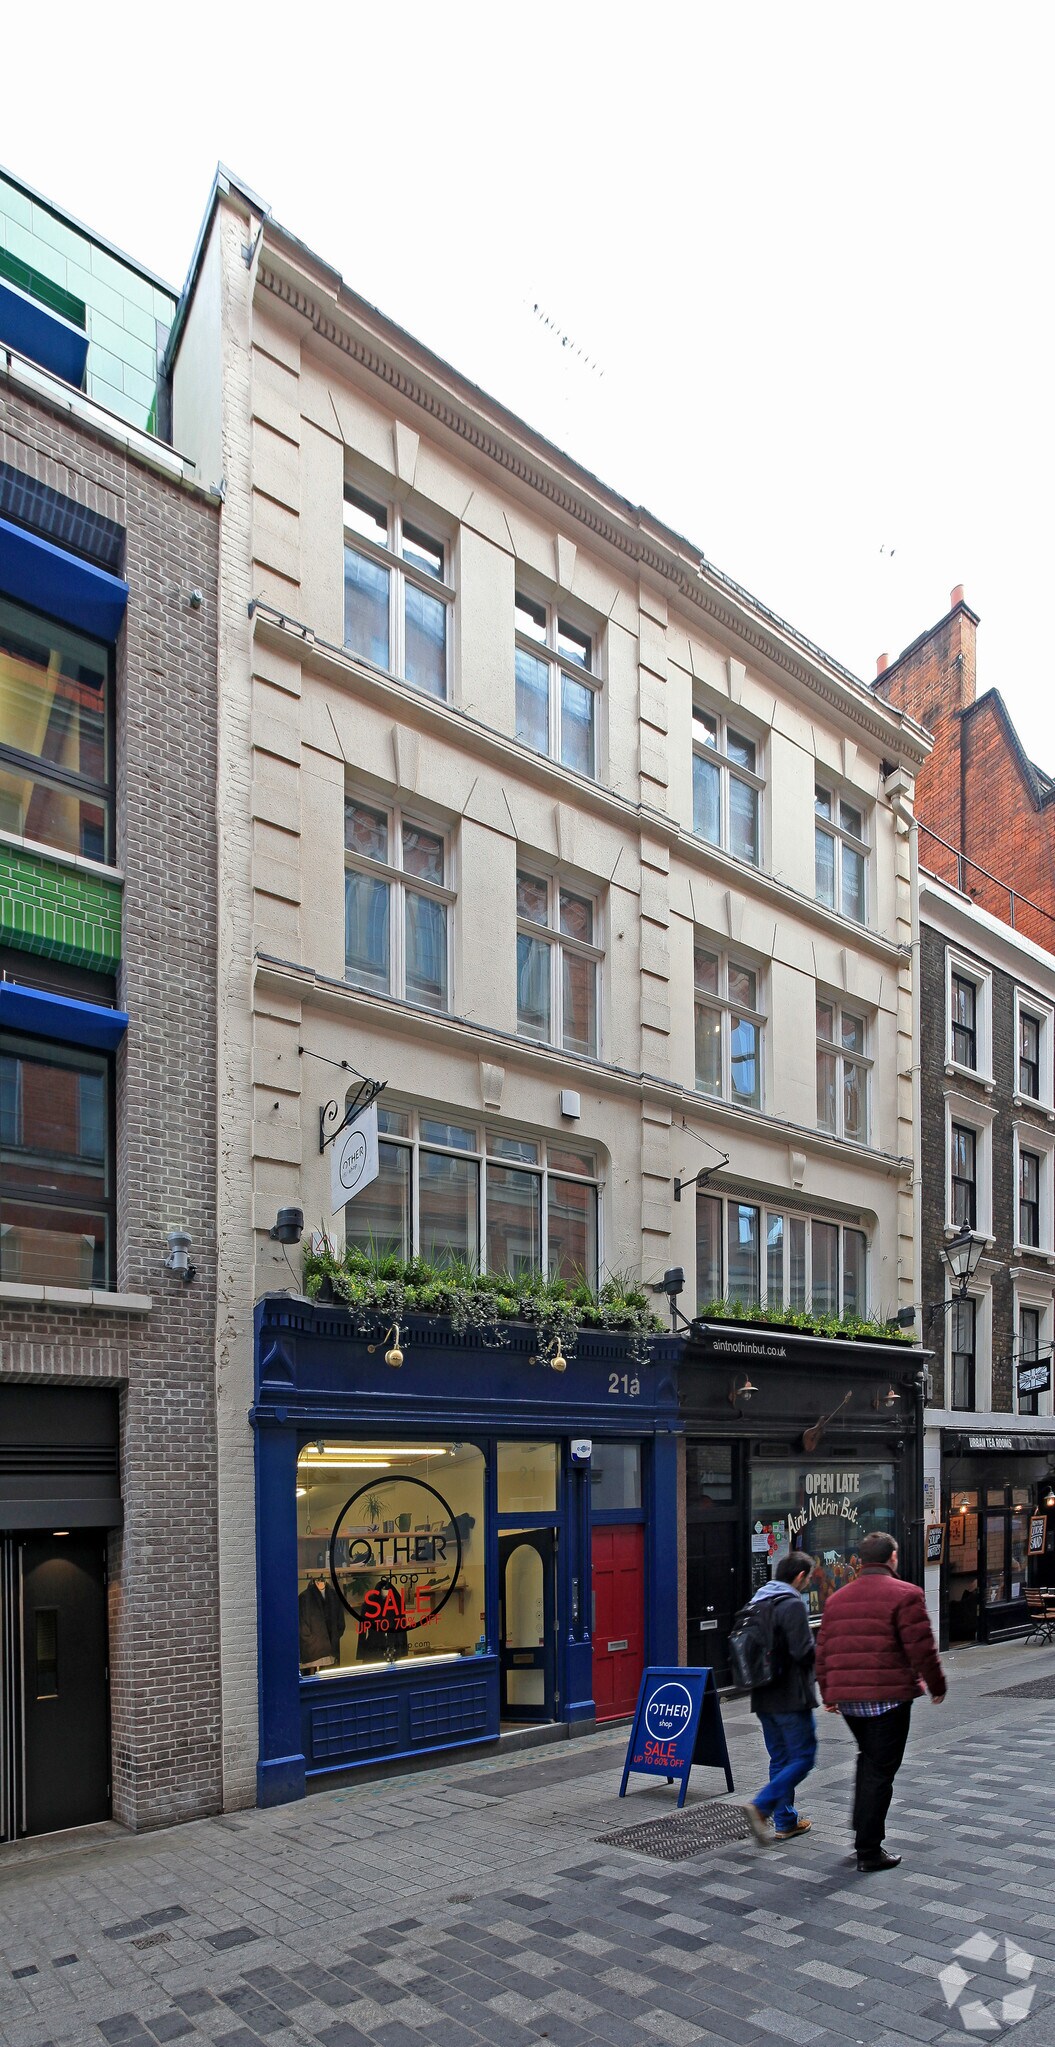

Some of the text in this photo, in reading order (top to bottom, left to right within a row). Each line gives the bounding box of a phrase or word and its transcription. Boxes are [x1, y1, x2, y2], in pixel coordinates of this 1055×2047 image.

[343, 1146, 364, 1169] OTHER
[713, 1339, 787, 1357] aintnothinbut.co.uk
[608, 1373, 640, 1395] 21a
[968, 1437, 1012, 1448] URBAN TEA ROOMS
[805, 1473, 834, 1495] OPEN
[836, 1473, 860, 1493] LATE
[349, 1535, 447, 1566] OTHER
[380, 1569, 419, 1588] shop
[364, 1585, 432, 1619] SALE
[355, 1613, 442, 1634] UP TO 70% OFF
[649, 1703, 689, 1718] OTHER
[659, 1719, 673, 1729] shop
[644, 1741, 677, 1758] SALE
[644, 1757, 653, 1765] TO
[654, 1758, 669, 1767] 60%
[670, 1759, 685, 1768] OFF
